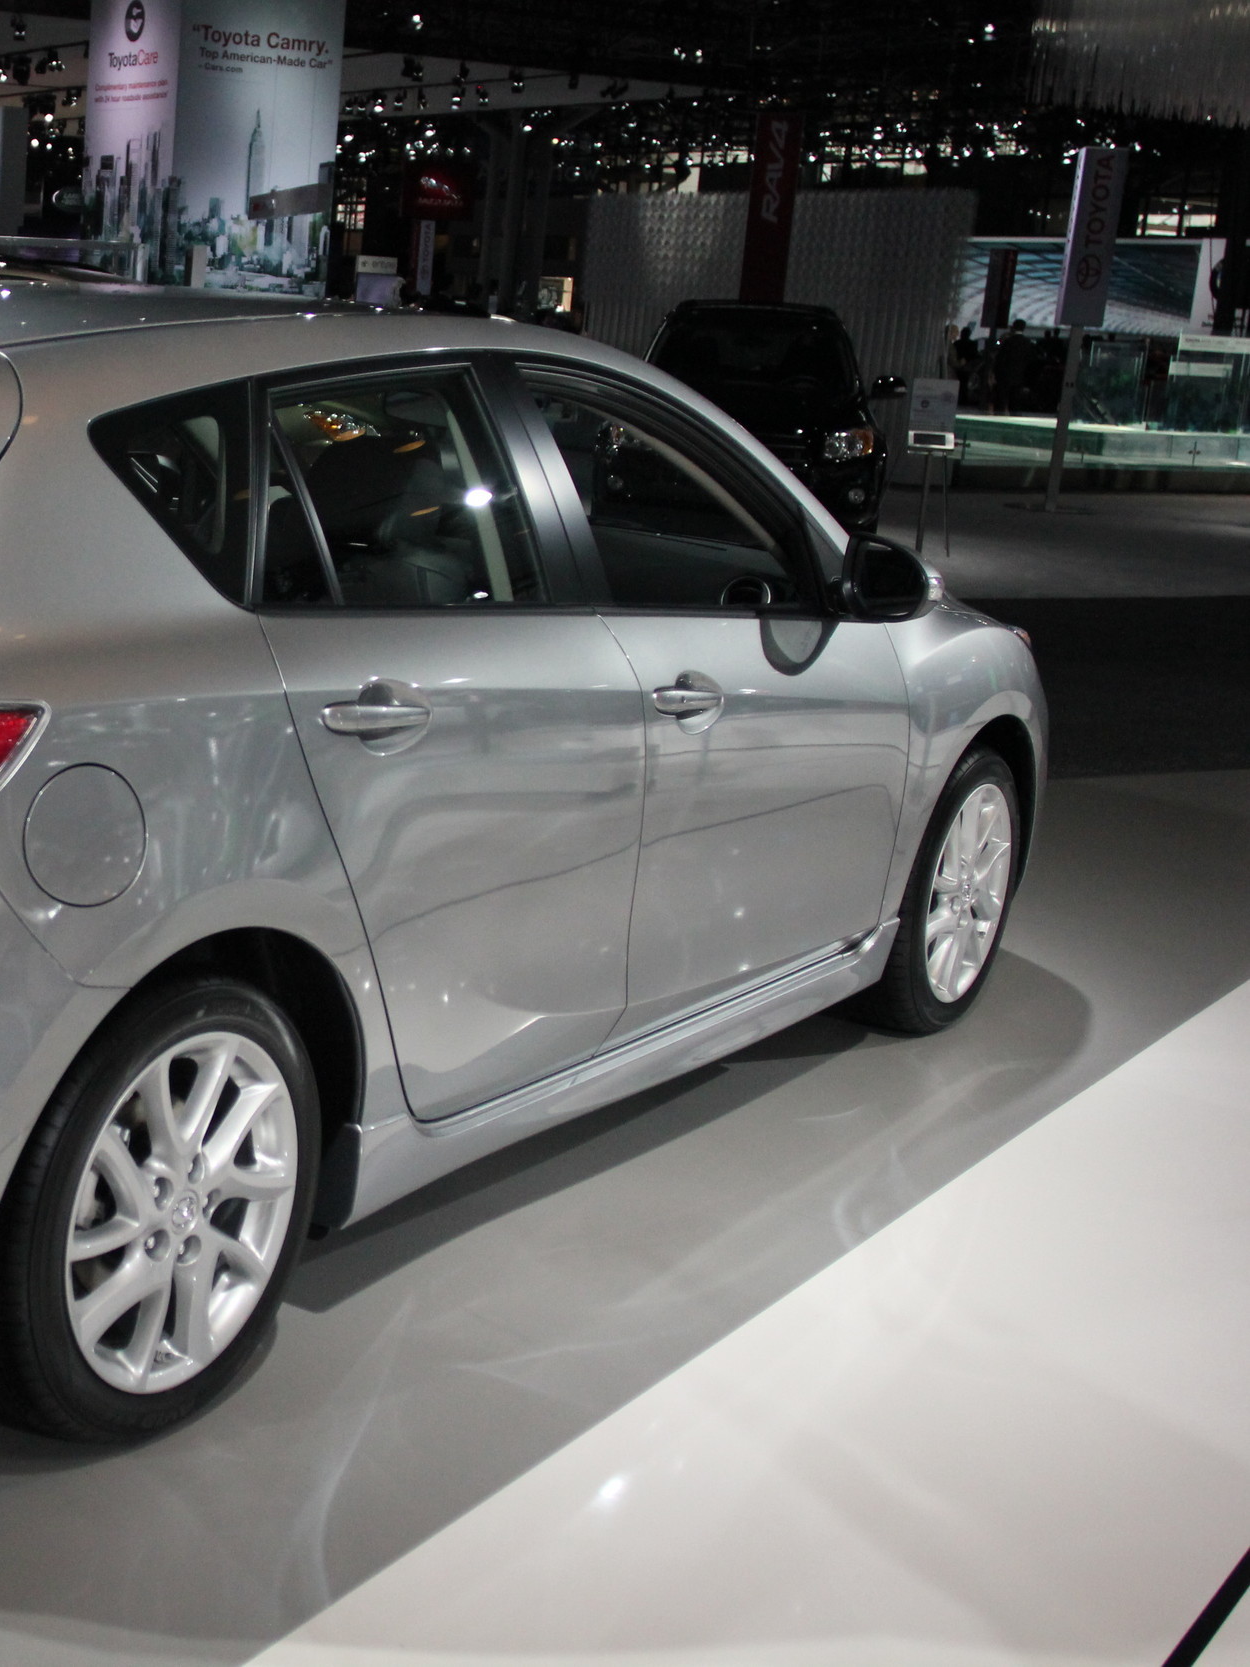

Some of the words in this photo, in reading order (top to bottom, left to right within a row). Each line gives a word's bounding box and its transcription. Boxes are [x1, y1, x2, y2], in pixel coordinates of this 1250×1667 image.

[267, 32, 330, 56] Camry.
[108, 49, 159, 71] ToyotaCare
[200, 46, 219, 59] Top
[221, 50, 306, 68] American-Made
[204, 62, 244, 73] Cars.com
[760, 120, 789, 224] RAV4
[1085, 154, 1115, 249] TOYOTA
